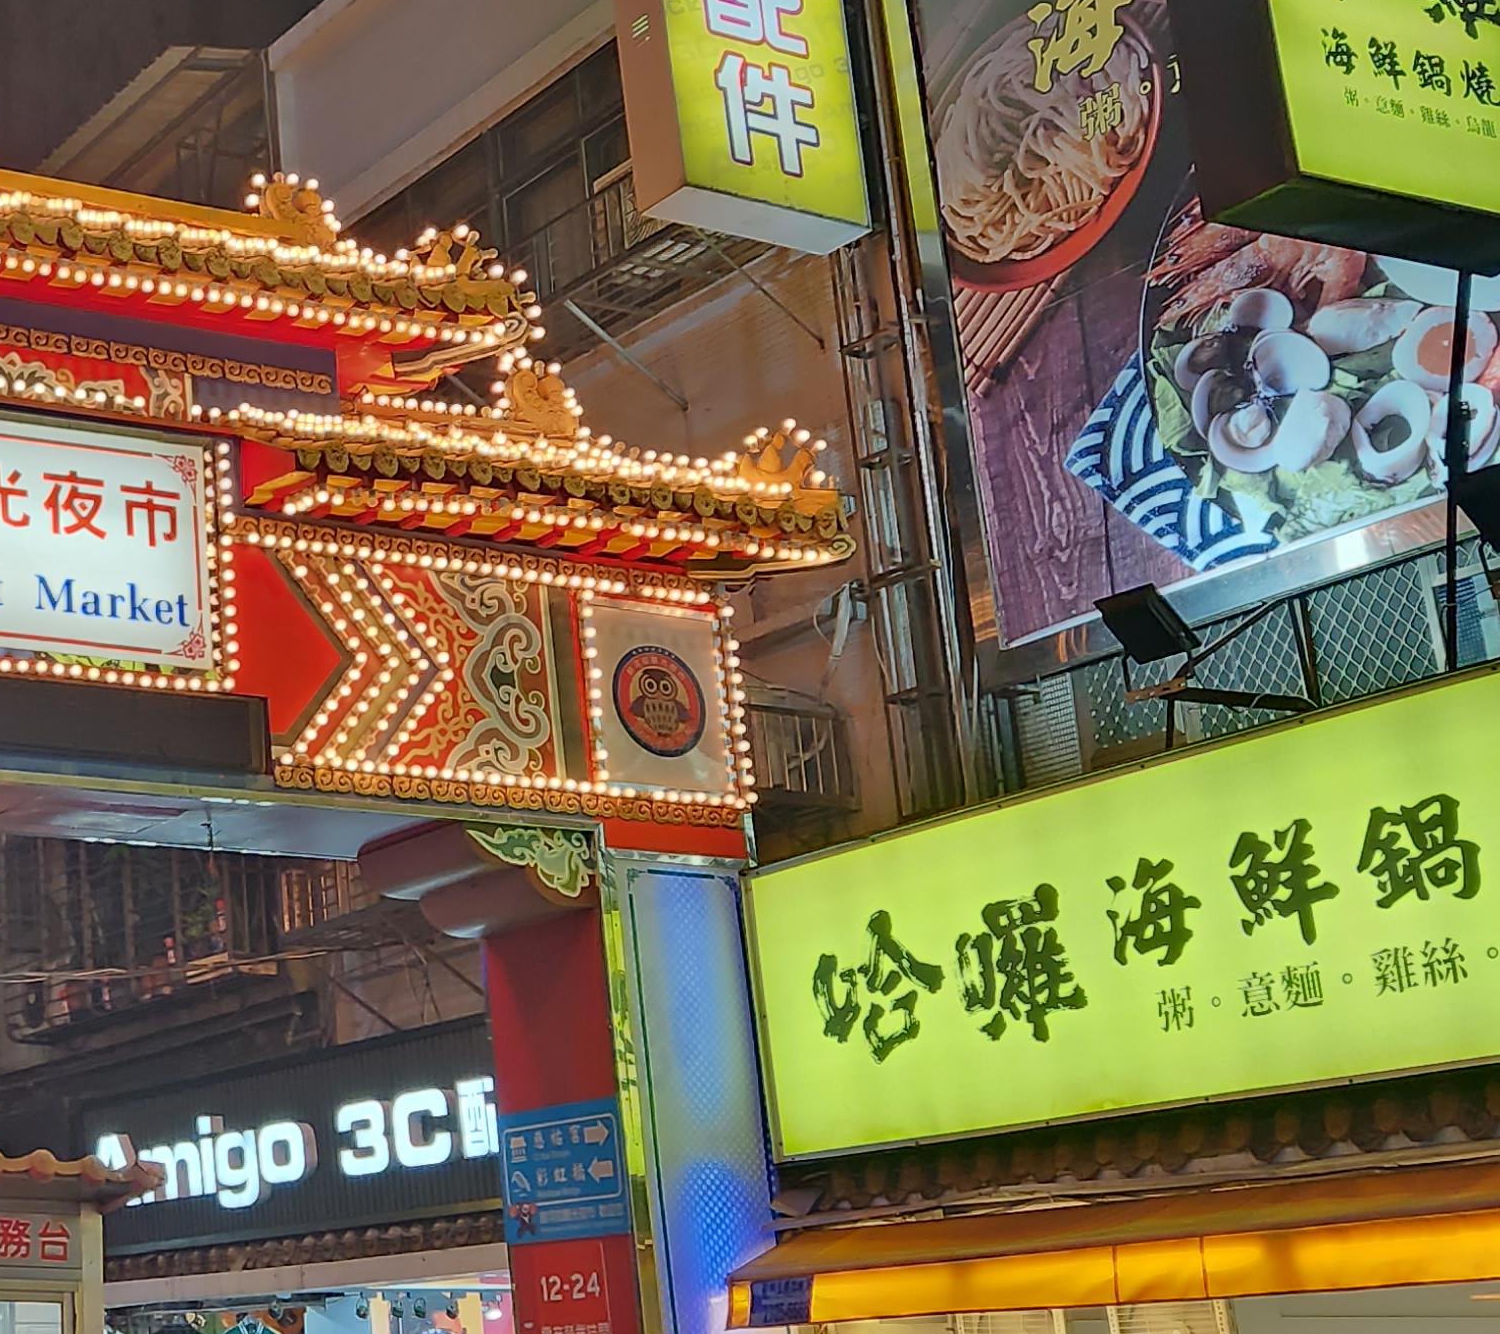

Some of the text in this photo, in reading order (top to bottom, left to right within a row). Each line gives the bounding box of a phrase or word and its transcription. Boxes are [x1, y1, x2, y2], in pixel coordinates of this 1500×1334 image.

[1321, 26, 1500, 106] 海鮮鍋燒
[35, 574, 190, 628] Market
